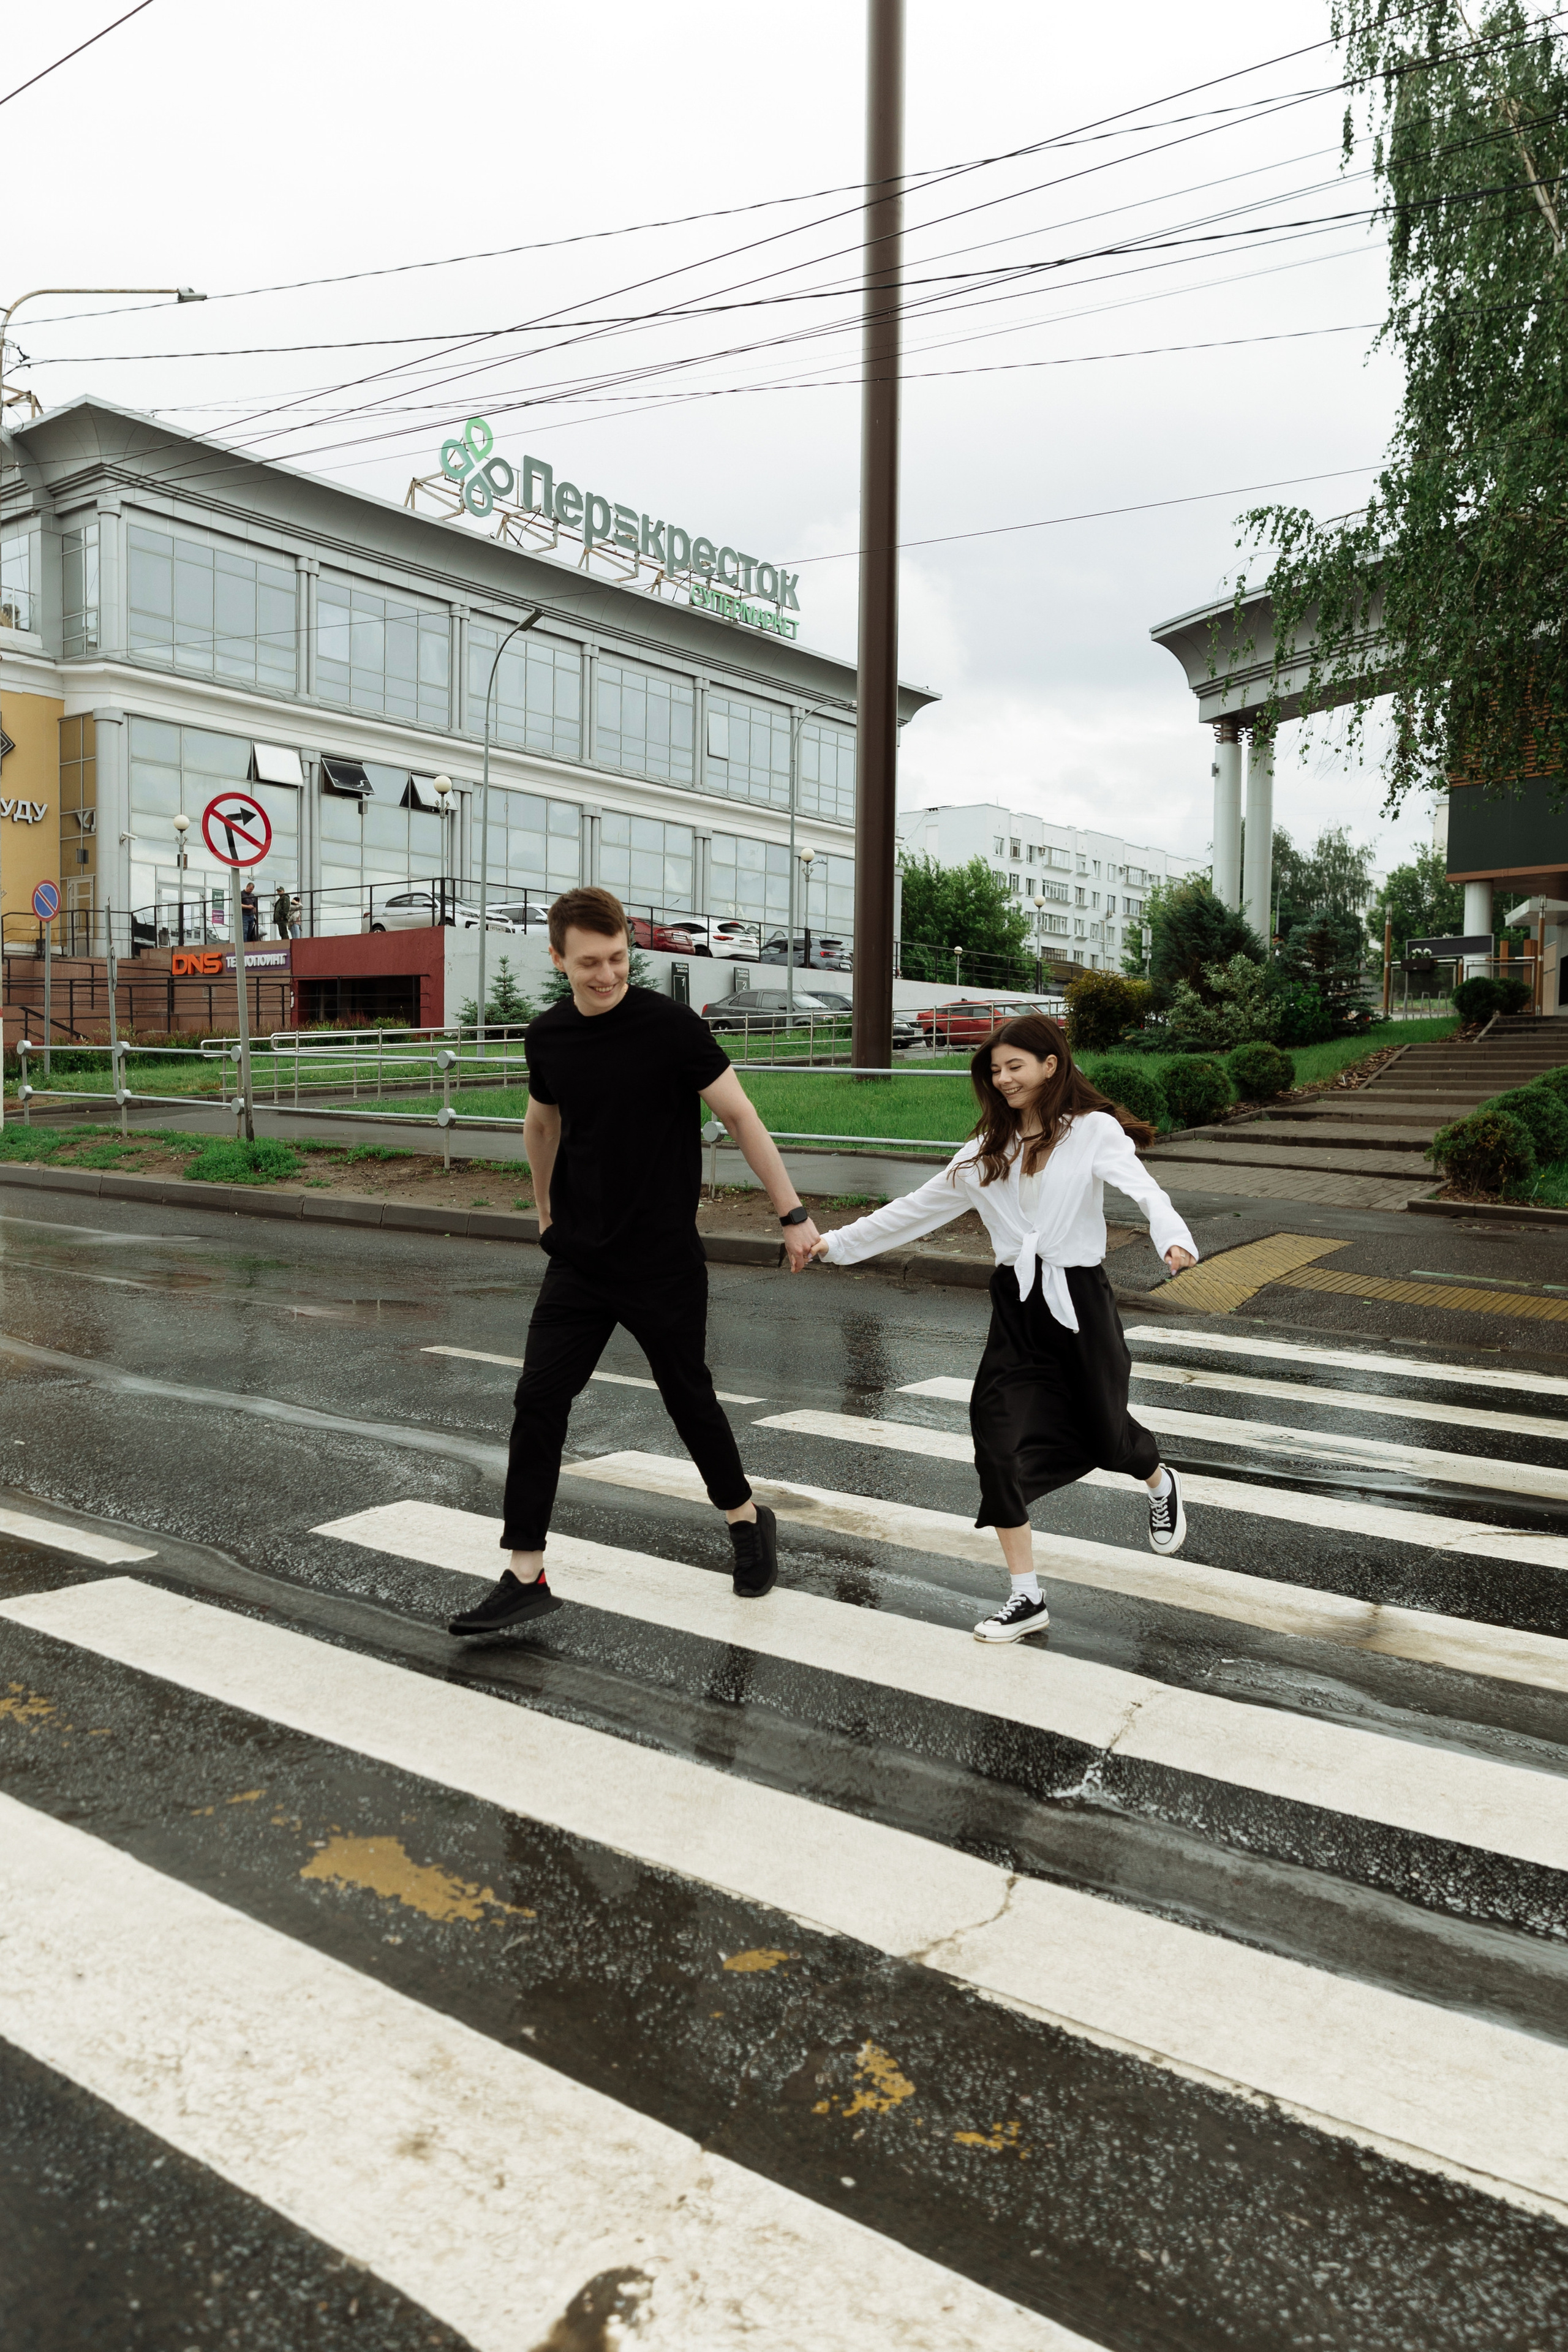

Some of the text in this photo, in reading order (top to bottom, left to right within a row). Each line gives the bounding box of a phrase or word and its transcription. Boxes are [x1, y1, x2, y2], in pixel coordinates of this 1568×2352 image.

[690, 584, 800, 640] СУПЕРМАРКЕТ
[172, 952, 223, 975] DNS
[681, 978, 685, 987] 1
[742, 982, 747, 990] 2
